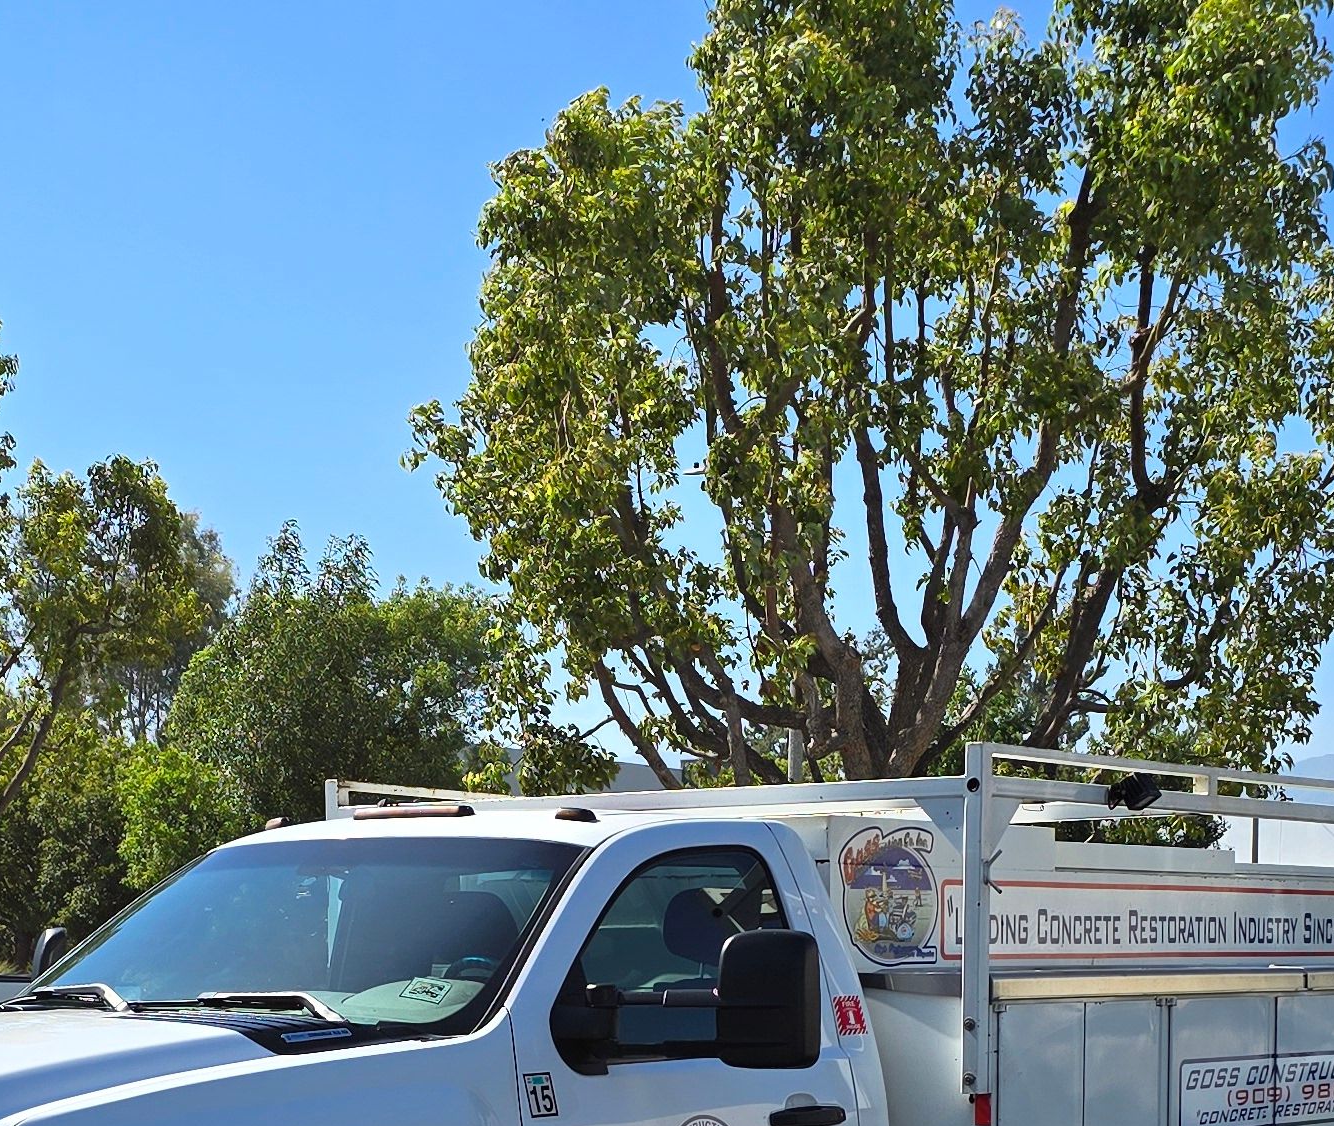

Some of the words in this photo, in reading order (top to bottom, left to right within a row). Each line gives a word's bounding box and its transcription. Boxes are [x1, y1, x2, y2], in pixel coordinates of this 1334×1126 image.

[948, 895, 1028, 945] "LDING
[1037, 908, 1121, 945] CONCRETE
[1128, 909, 1227, 945] RESTORATION
[1234, 911, 1298, 945] INDUSTRY
[1186, 1066, 1239, 1091] GOSS
[530, 1085, 554, 1113] 15
[1227, 1087, 1291, 1107] (909)
